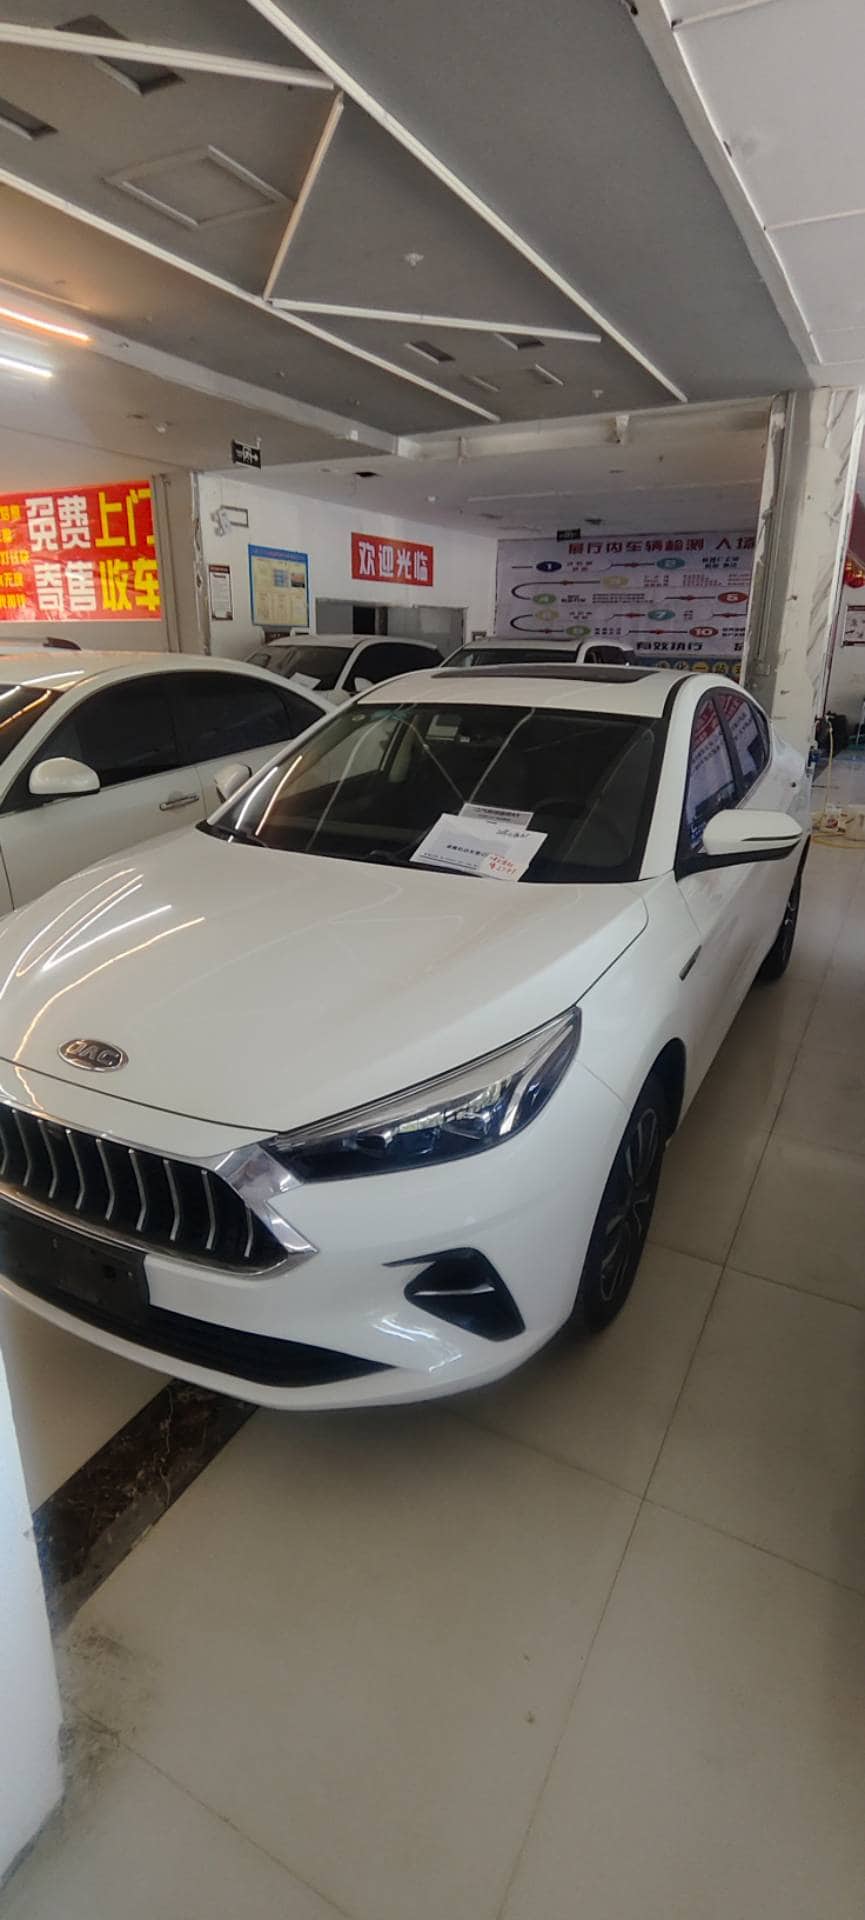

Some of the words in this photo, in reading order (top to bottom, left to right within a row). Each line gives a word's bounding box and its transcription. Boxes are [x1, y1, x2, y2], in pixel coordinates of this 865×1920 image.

[358, 540, 429, 581] 欢迎光临
[693, 628, 713, 636] 10
